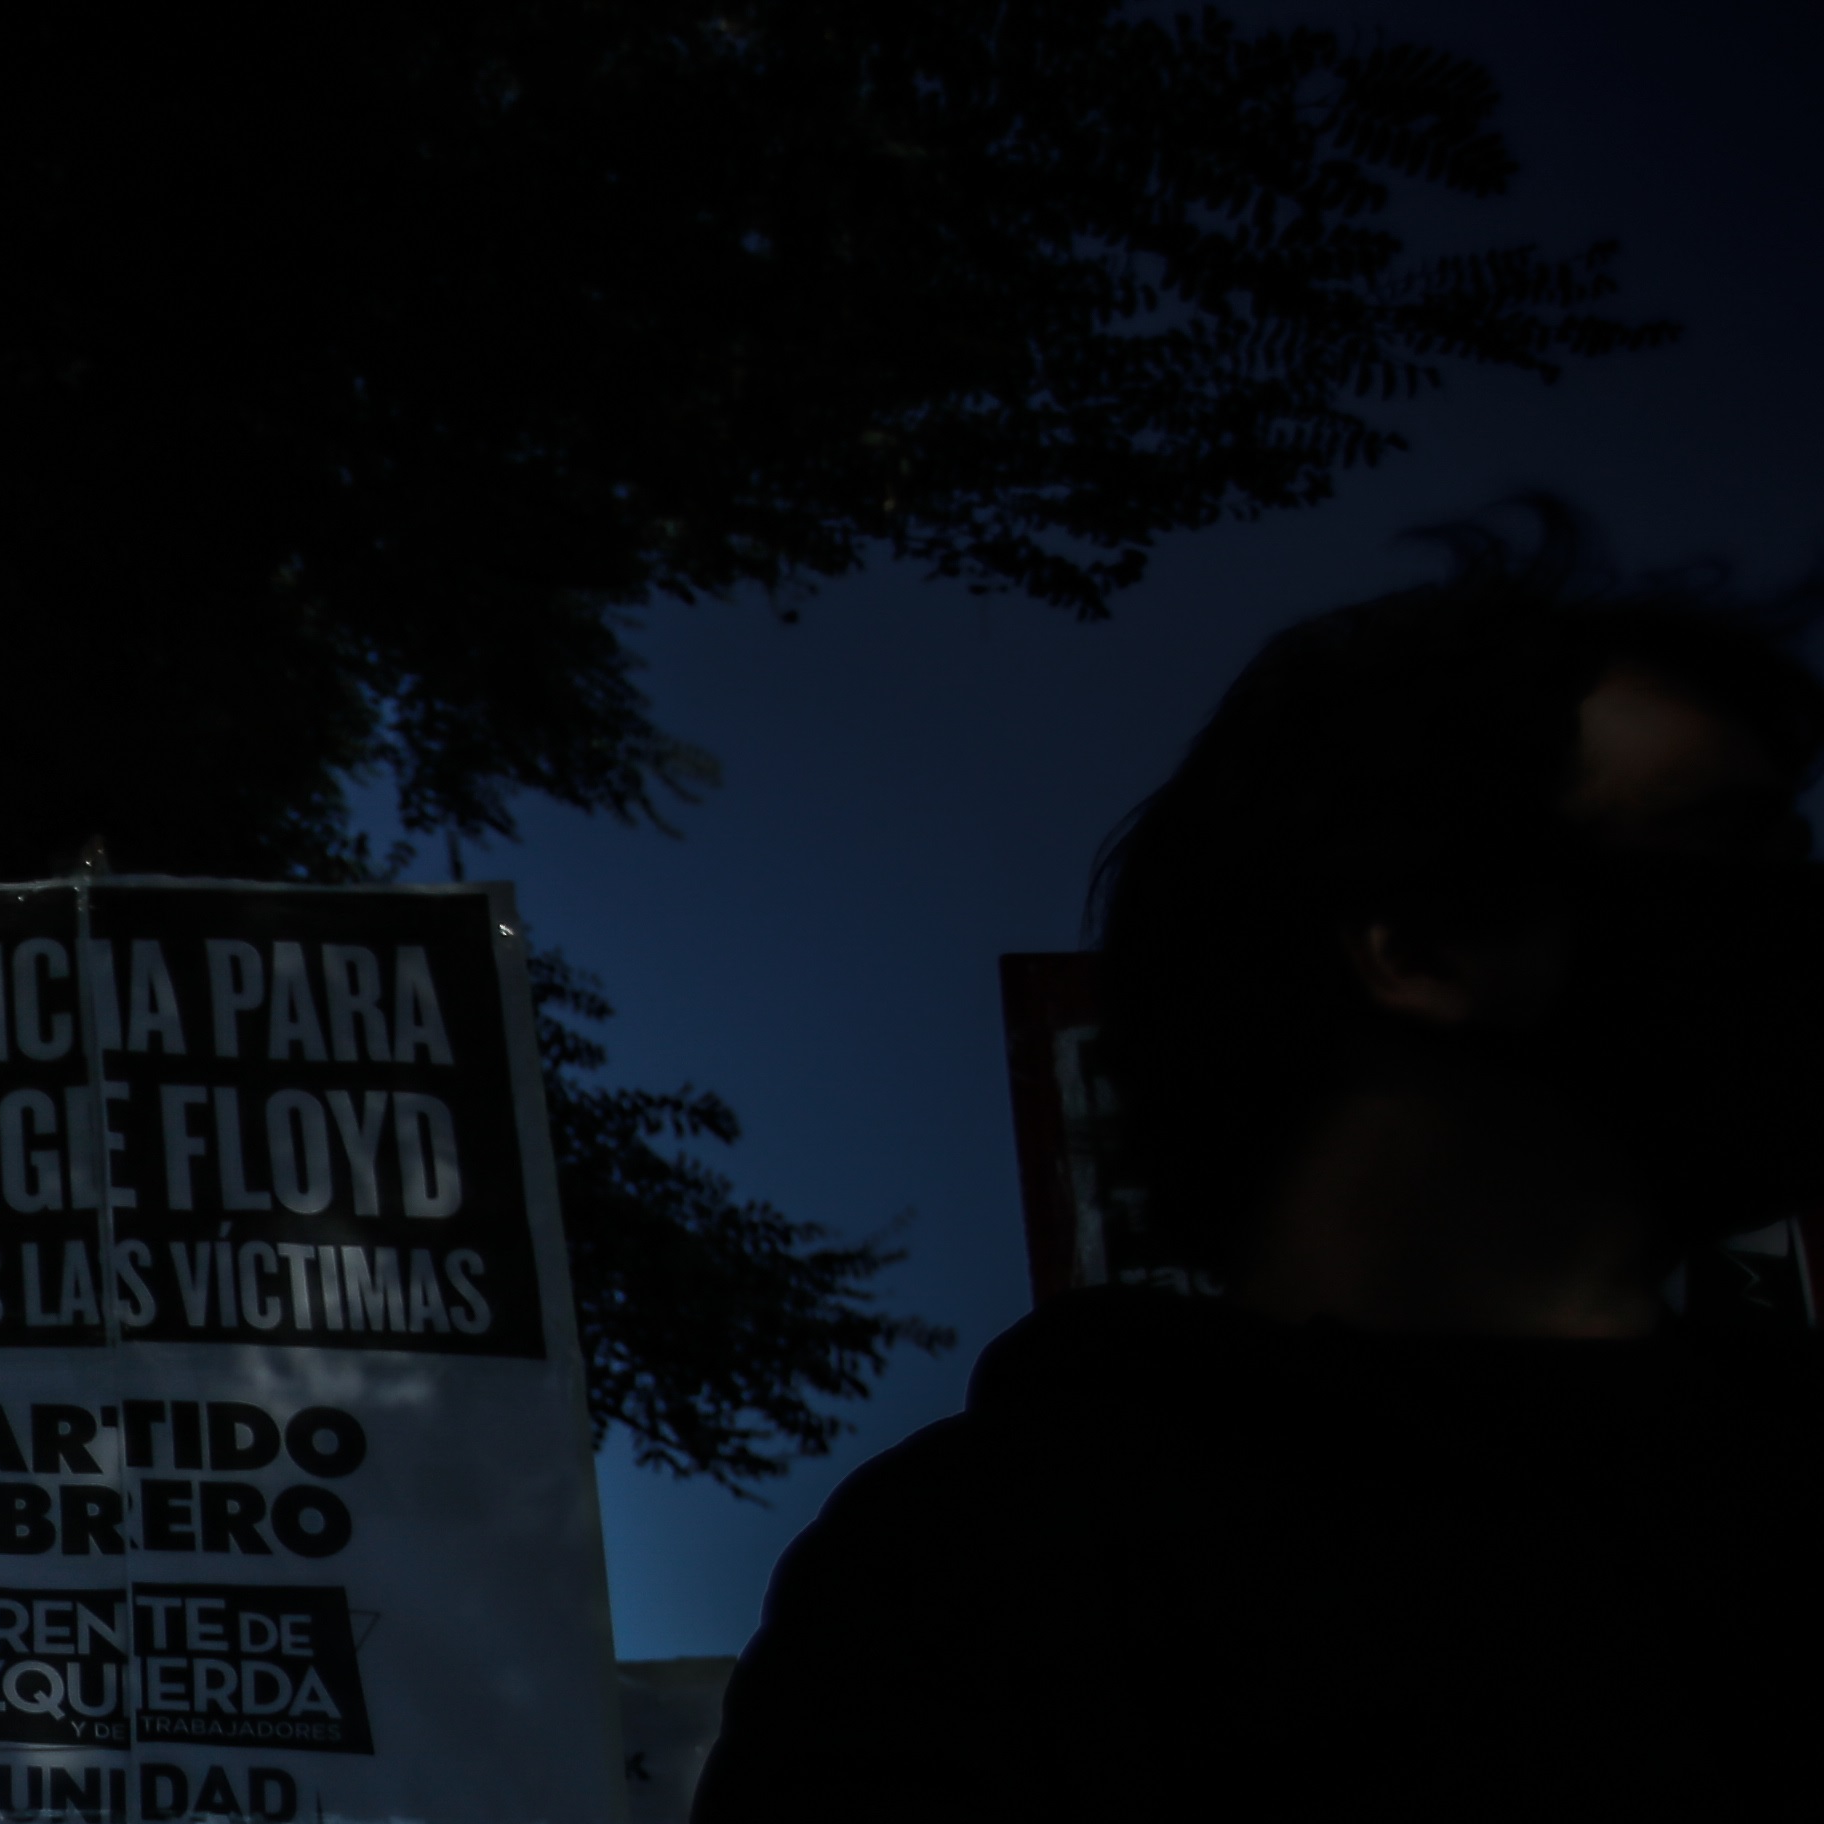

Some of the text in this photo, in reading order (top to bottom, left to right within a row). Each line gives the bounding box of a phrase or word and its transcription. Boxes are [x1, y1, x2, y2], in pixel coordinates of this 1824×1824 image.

[203, 936, 456, 1068] PARA
[156, 1083, 464, 1221] FLOYD
[22, 1238, 155, 1331] LAS
[169, 1220, 494, 1337] VÍCTIMAS
[237, 1612, 316, 1658] DE
[69, 1715, 342, 1743] Y DE TRABAJADORES
